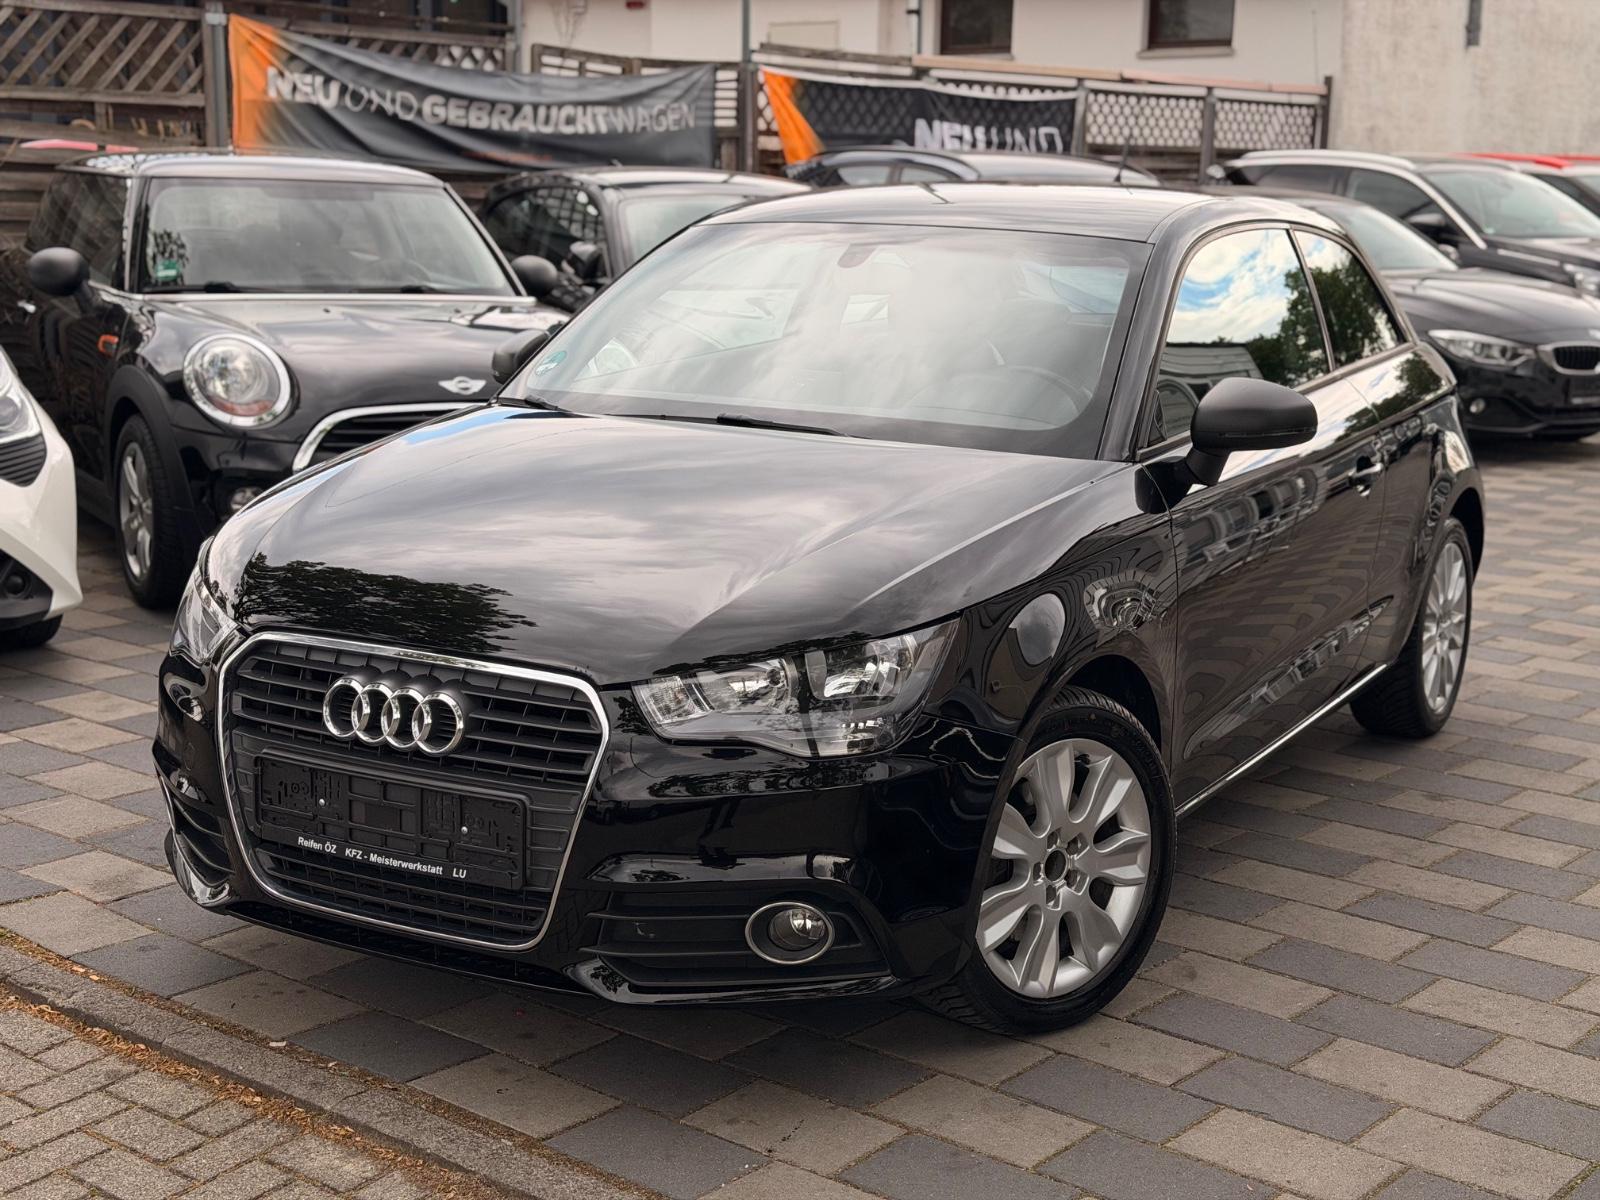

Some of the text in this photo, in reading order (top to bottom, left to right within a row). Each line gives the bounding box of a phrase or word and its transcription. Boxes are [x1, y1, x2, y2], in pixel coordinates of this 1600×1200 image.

[266, 65, 341, 110] NEU
[421, 94, 697, 135] GEBRAUCHTWAGEN
[297, 836, 323, 851] Reifen
[324, 841, 337, 854] ÖZ
[344, 847, 363, 860] KFZ
[369, 852, 443, 876] Meisterwerkstatt
[452, 867, 467, 879] LU
